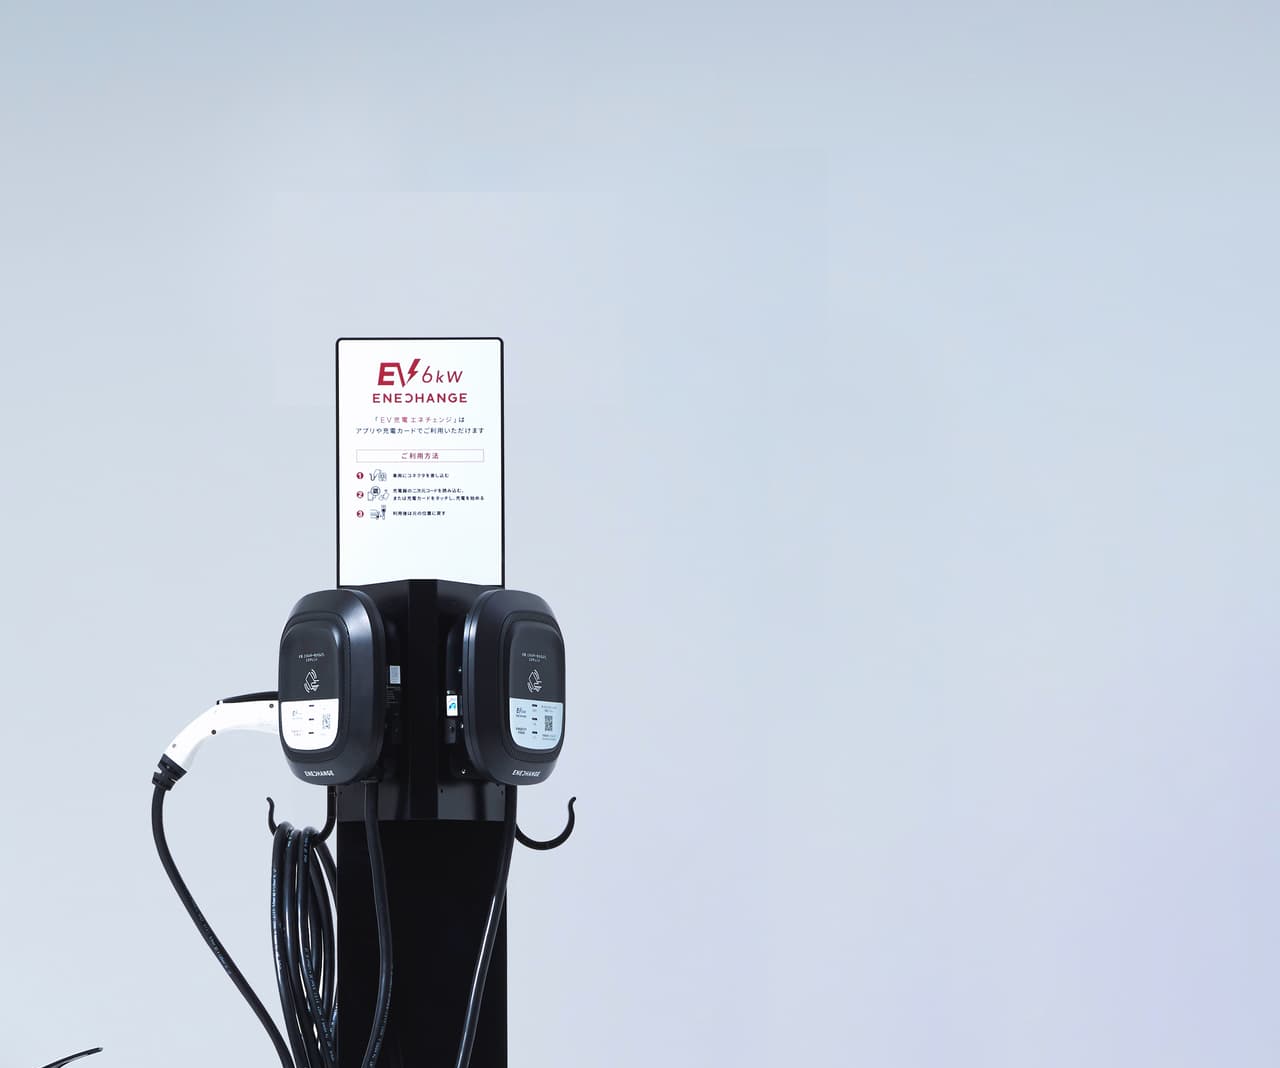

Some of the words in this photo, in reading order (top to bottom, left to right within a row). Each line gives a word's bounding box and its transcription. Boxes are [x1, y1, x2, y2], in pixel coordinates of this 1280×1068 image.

[377, 358, 421, 387] EV
[422, 365, 463, 384] 6kW
[372, 393, 467, 404] ENECHANGE
[356, 427, 485, 435] アプリや充電カードでご利用いただけます
[401, 452, 439, 460] ご利用方法
